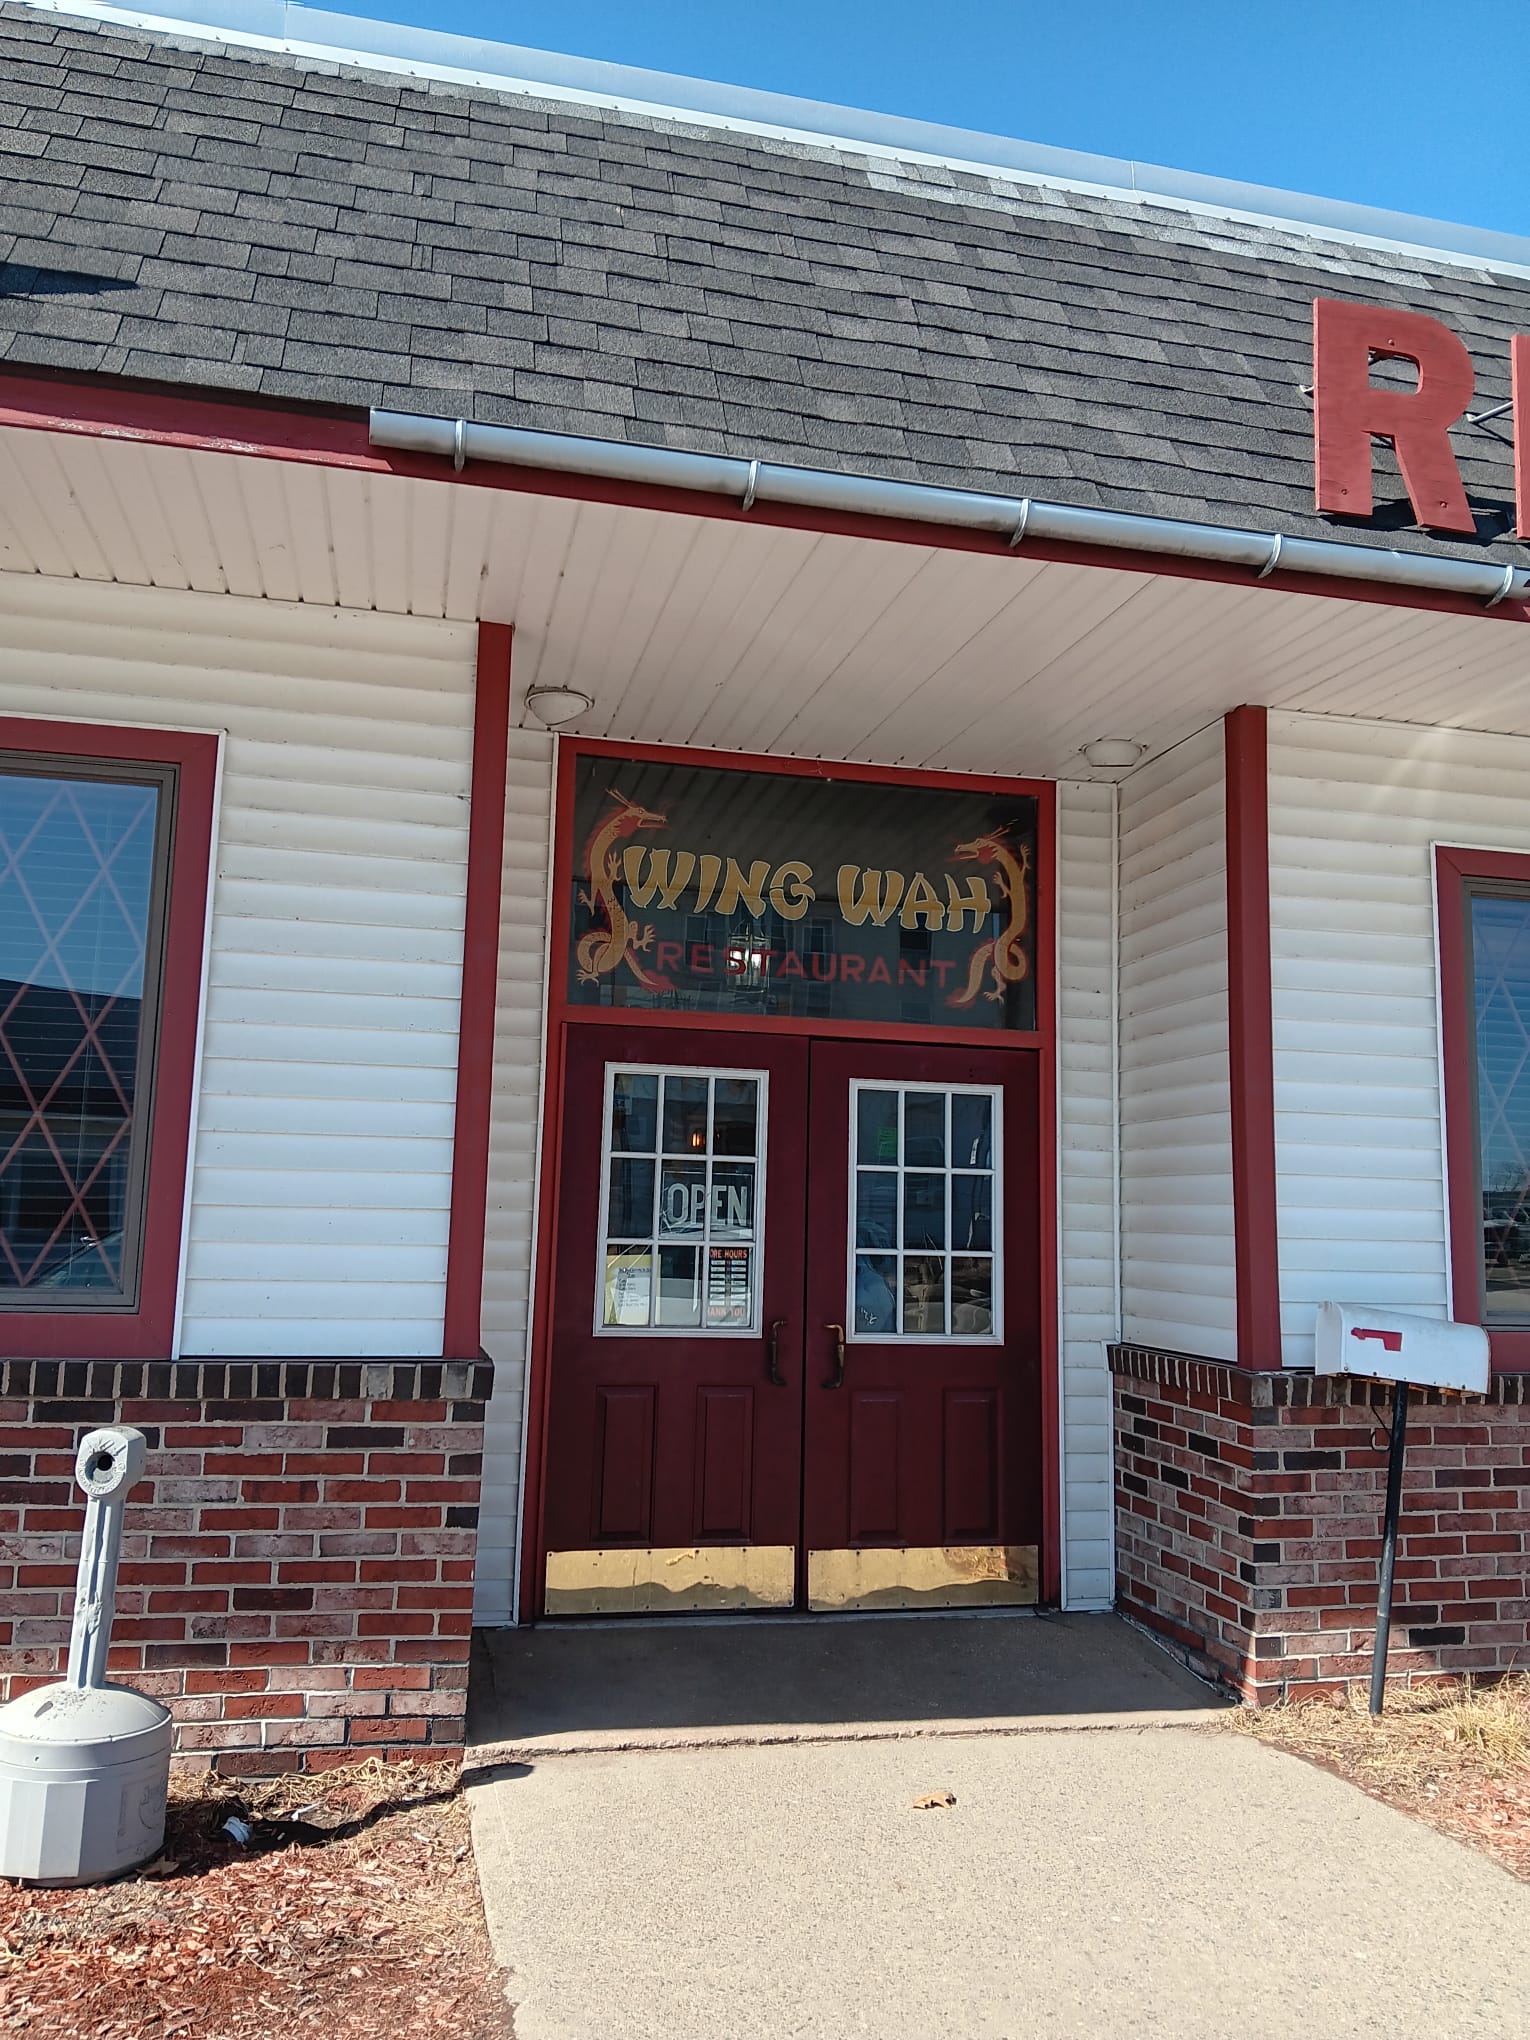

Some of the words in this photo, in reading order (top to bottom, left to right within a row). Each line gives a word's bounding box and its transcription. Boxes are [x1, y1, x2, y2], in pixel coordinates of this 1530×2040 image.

[1313, 297, 1530, 540] R
[622, 845, 816, 921] WING
[836, 864, 992, 934] WAH
[656, 942, 957, 989] RESTAURANT
[666, 1182, 748, 1227] OPEN
[709, 1247, 723, 1260] ORE
[724, 1247, 748, 1260] HOURS
